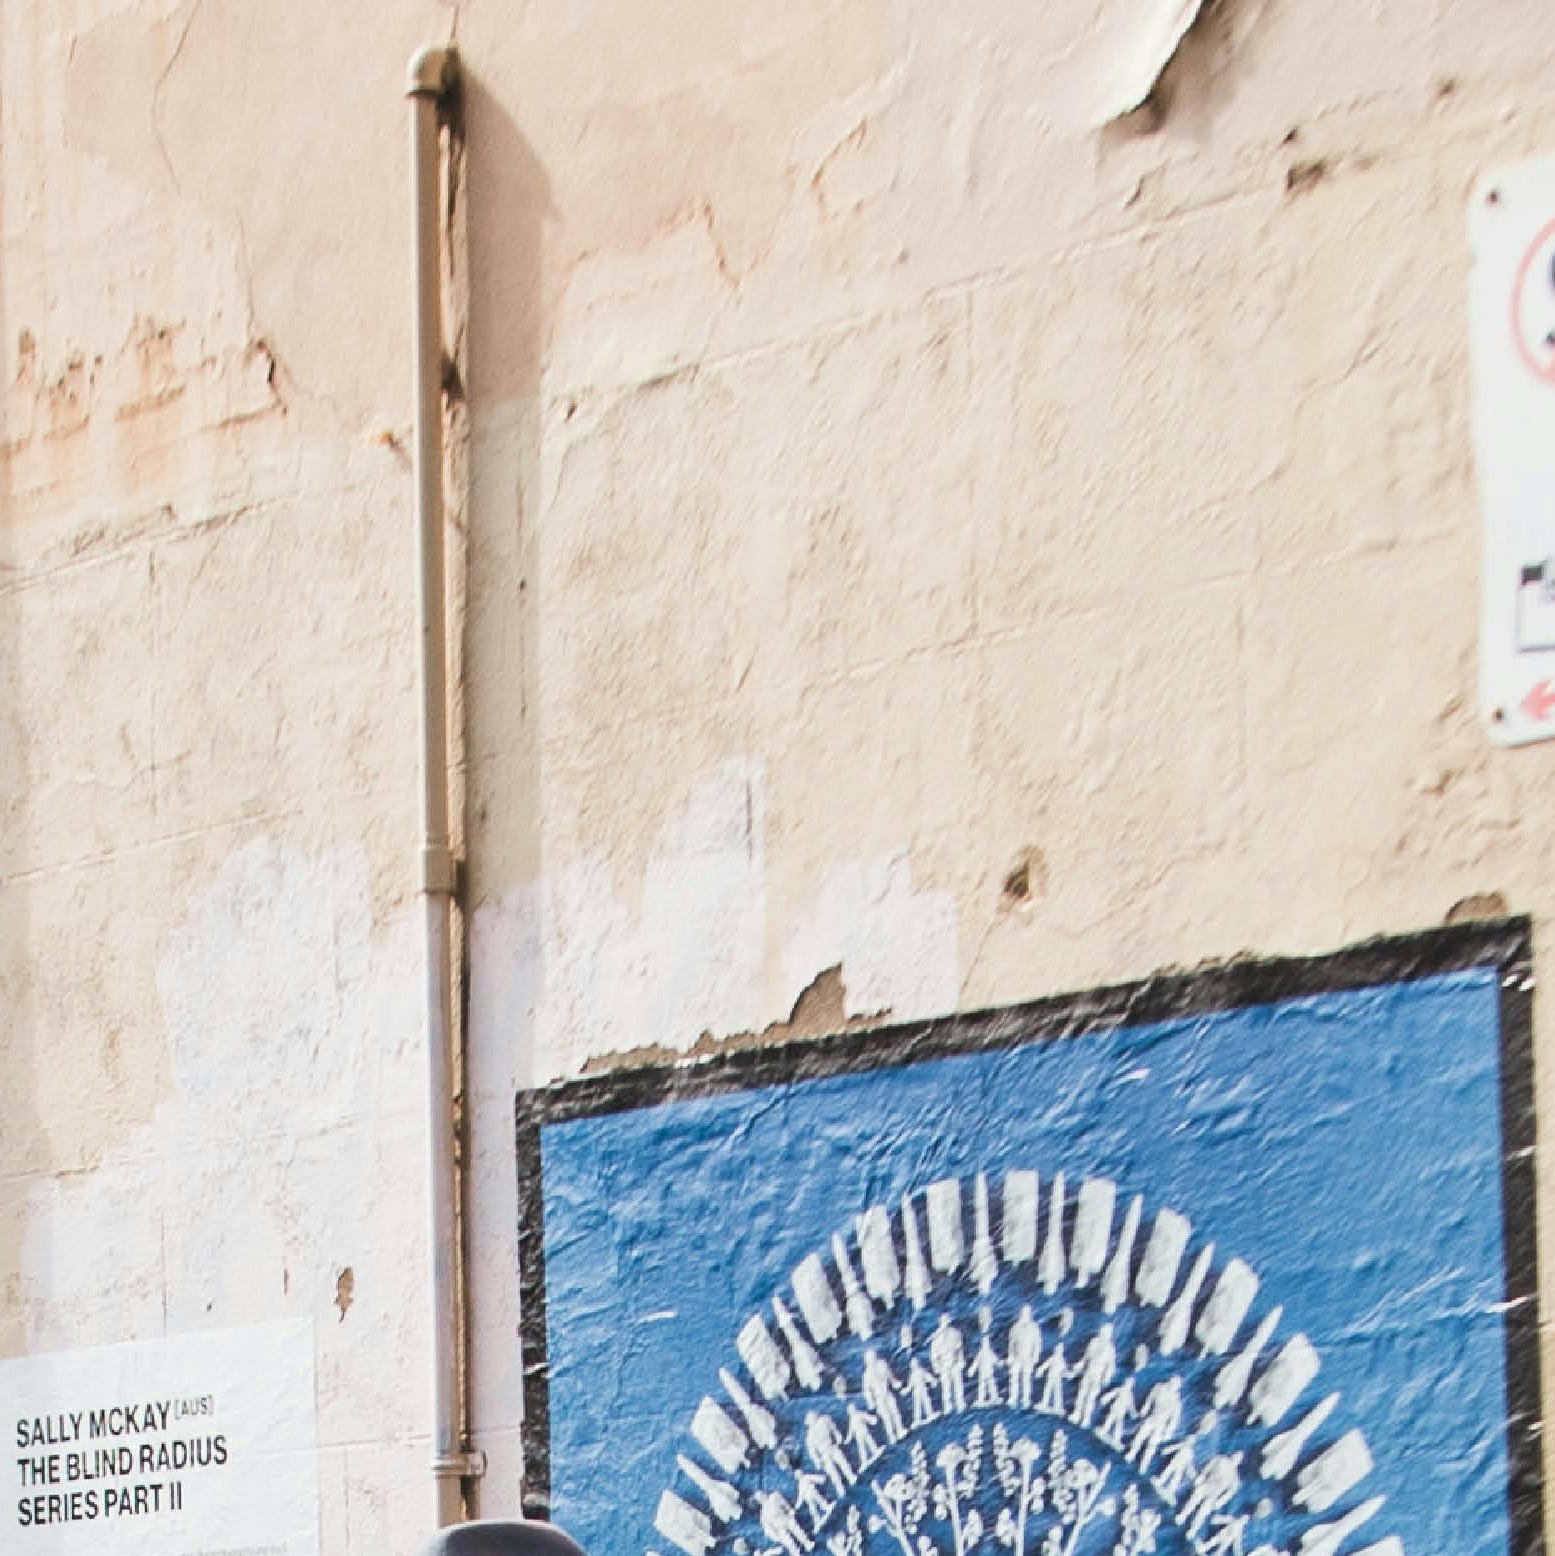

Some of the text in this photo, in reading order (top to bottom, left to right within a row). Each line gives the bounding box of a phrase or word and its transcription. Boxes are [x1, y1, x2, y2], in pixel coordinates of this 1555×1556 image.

[16, 1410, 83, 1448] SALLY
[88, 1399, 171, 1440] MCKAY
[17, 1434, 229, 1487] THE BLIND RADIUS
[18, 1481, 183, 1528] SERIES PART II
